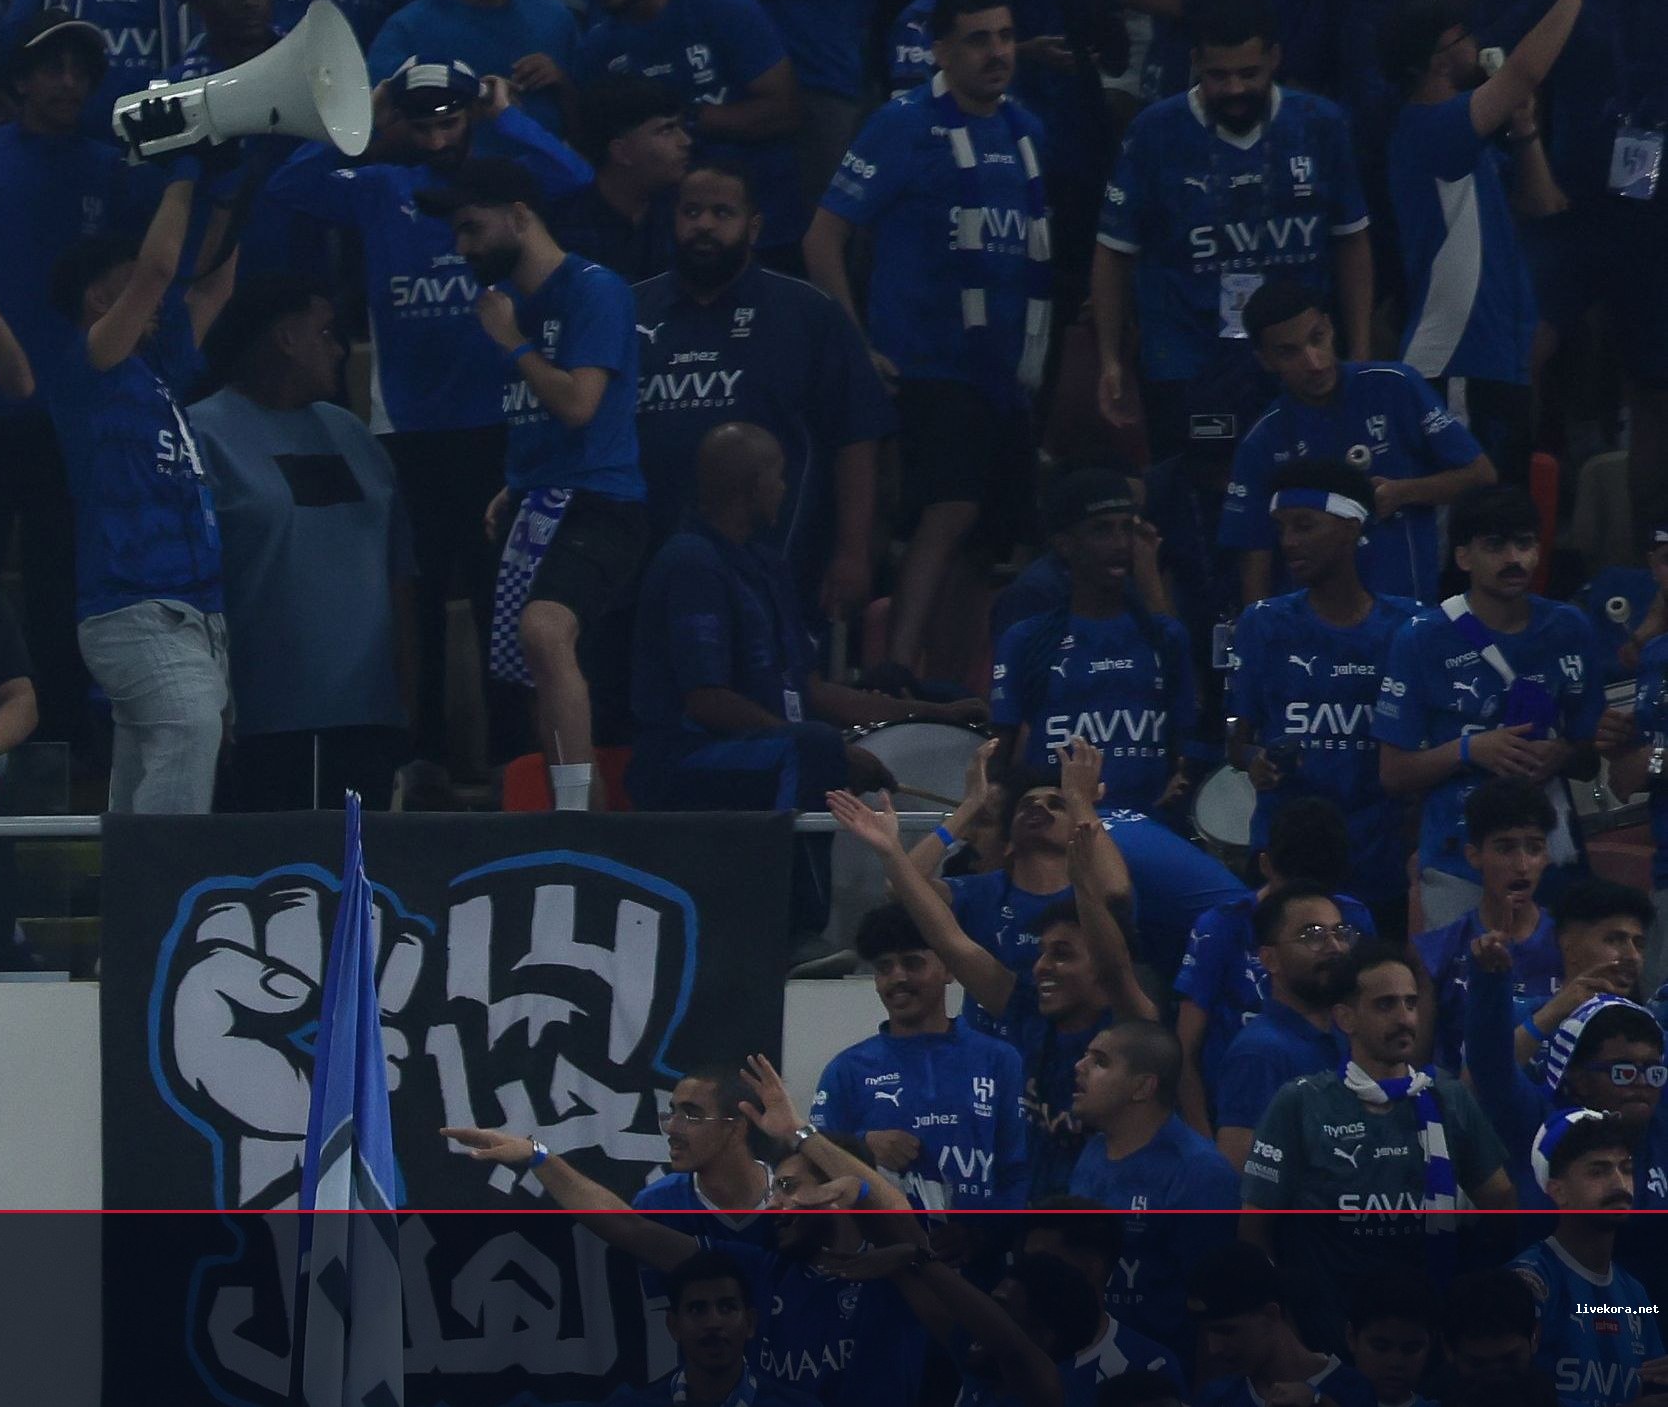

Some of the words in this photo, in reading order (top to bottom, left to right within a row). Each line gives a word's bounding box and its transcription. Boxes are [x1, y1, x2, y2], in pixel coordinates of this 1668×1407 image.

[391, 277, 477, 305] SAVV
[1046, 710, 1164, 749] SAVVY
[1284, 703, 1373, 734] SAV
[1339, 1195, 1428, 1223] SAVV
